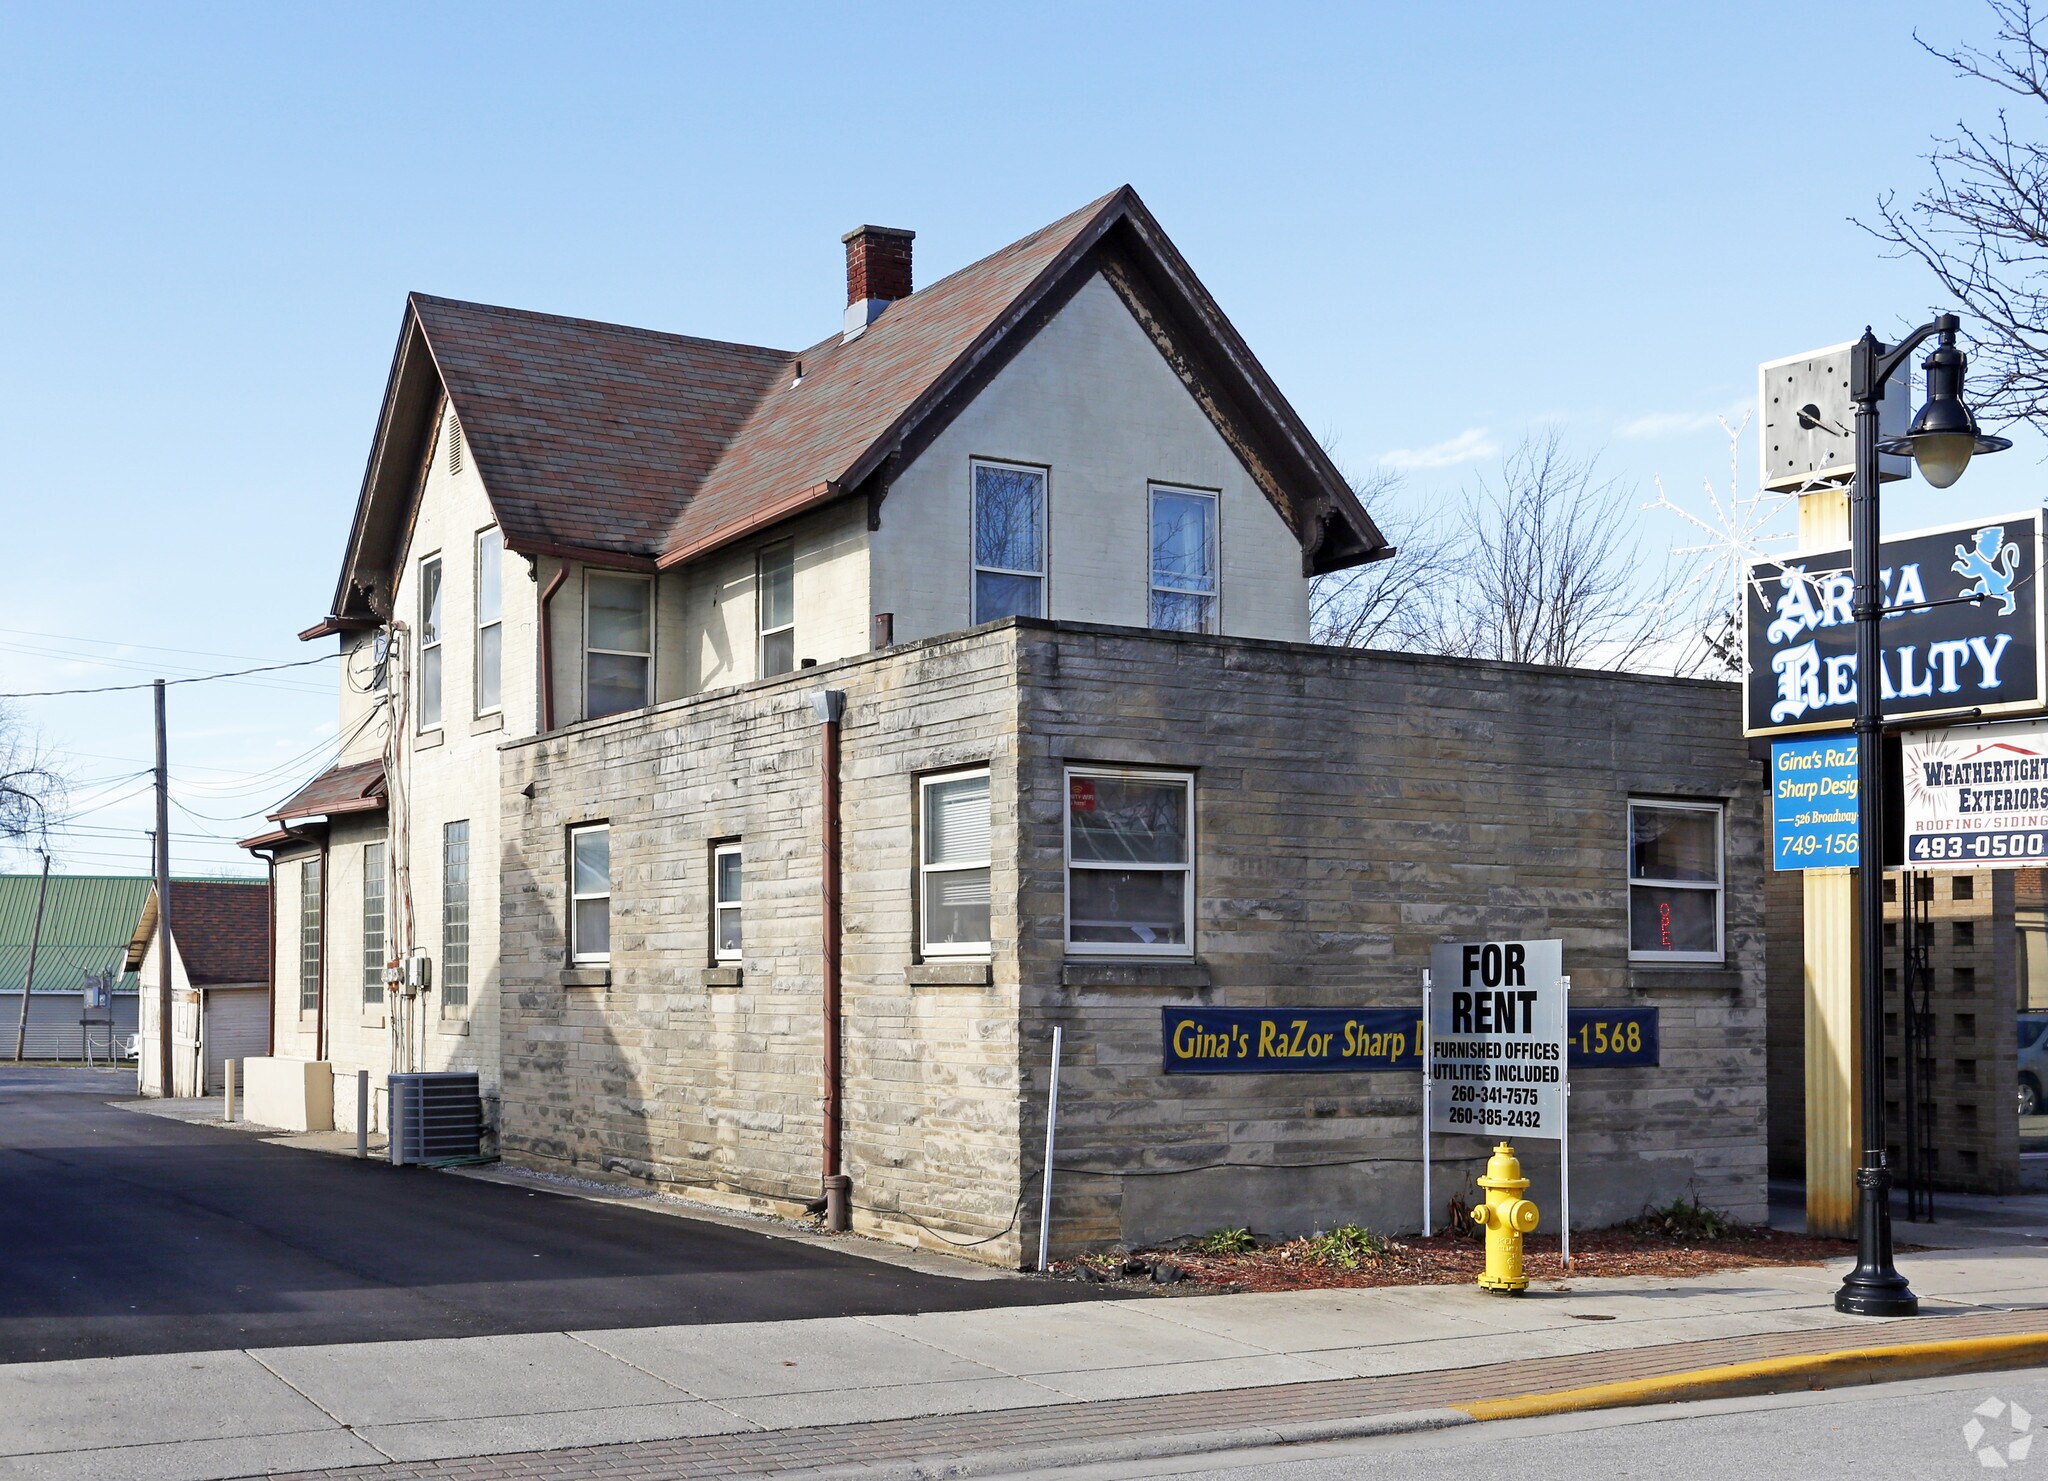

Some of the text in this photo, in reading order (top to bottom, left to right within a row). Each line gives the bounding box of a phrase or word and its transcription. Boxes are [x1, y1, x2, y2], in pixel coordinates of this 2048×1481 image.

[1778, 747, 1858, 771] Gina's RaZ
[1923, 758, 2048, 786] WEATHERTIGHT
[1778, 779, 1818, 802] Sharp
[1959, 787, 2048, 812] EXTERIORS
[1794, 808, 1857, 827] 526 Broadway
[1782, 833, 1859, 856] 749-156
[1915, 834, 2043, 858] 493-0500
[1462, 944, 1526, 987] FOR
[1452, 991, 1537, 1034] RENT
[1173, 1020, 1249, 1058] Gina's
[1257, 1020, 1334, 1058] RaZor
[1342, 1020, 1406, 1062] Sharp
[1433, 1042, 1560, 1060] FURNISHED OFFICES
[1433, 1064, 1560, 1083] UTILITIES INCLUDED
[1452, 1085, 1538, 1105] 260-341-7575
[1449, 1107, 1541, 1128] 260-385-2432
